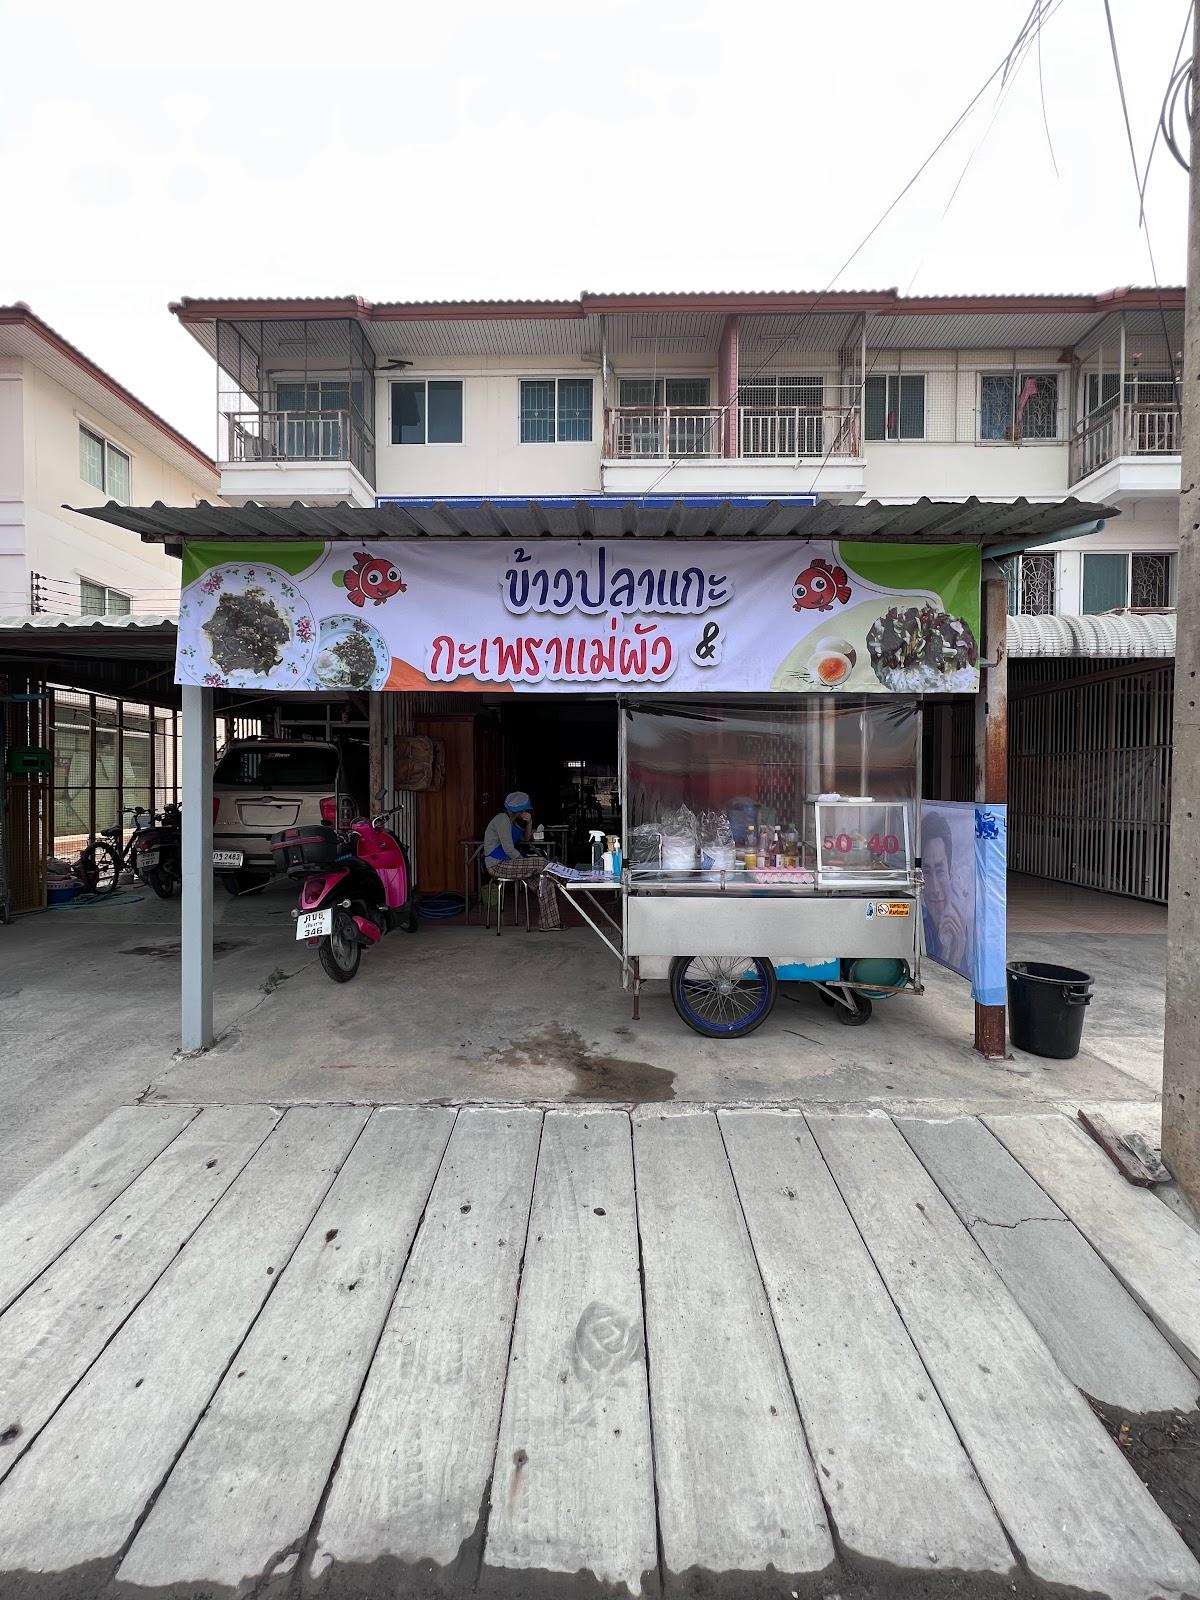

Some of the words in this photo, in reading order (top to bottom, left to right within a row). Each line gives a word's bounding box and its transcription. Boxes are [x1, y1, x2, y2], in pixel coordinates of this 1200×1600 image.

[505, 546, 727, 608] ข้าวปลาแกะ
[430, 617, 672, 676] กะเพราแม่ผัว
[695, 621, 720, 660] &
[823, 833, 853, 853] 50
[866, 832, 899, 855] 40
[304, 927, 323, 937] 346
